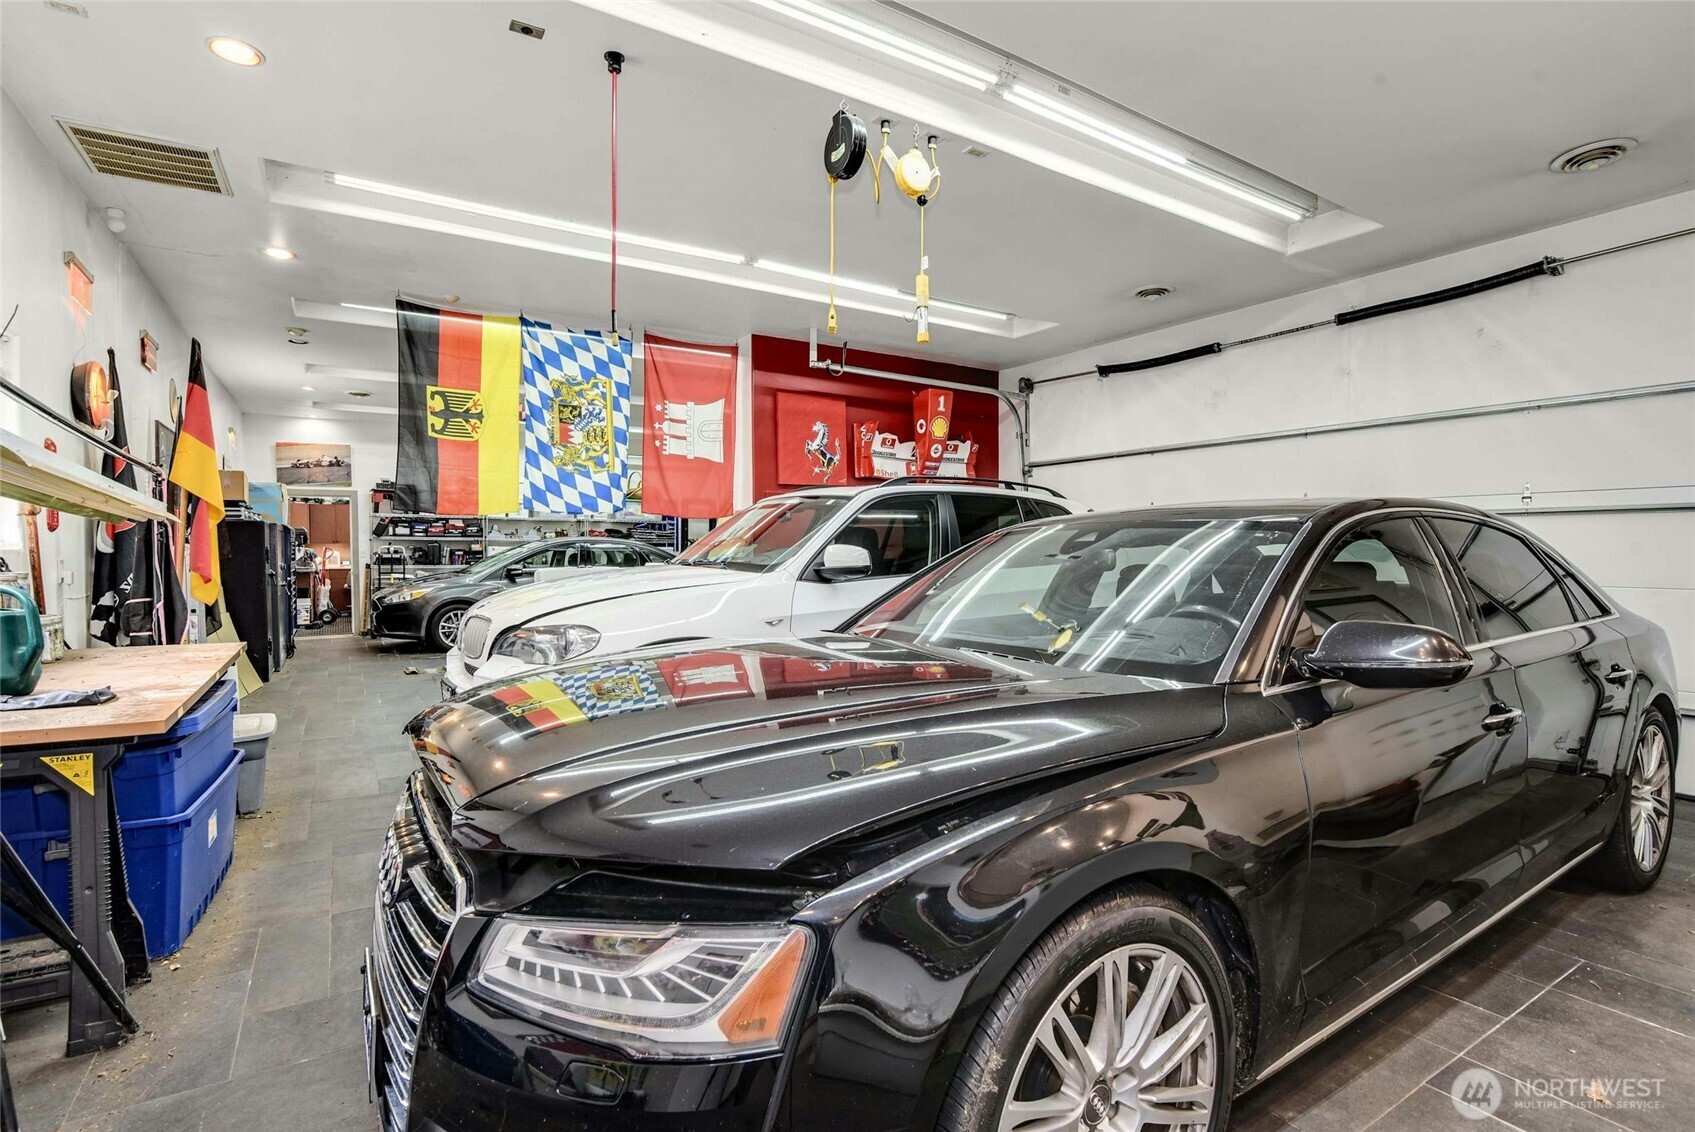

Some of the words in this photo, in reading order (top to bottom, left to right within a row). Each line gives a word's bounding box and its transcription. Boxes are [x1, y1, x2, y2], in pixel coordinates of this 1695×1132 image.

[938, 395, 945, 411] 1
[881, 470, 898, 478] Shell
[49, 754, 91, 764] STANLEY
